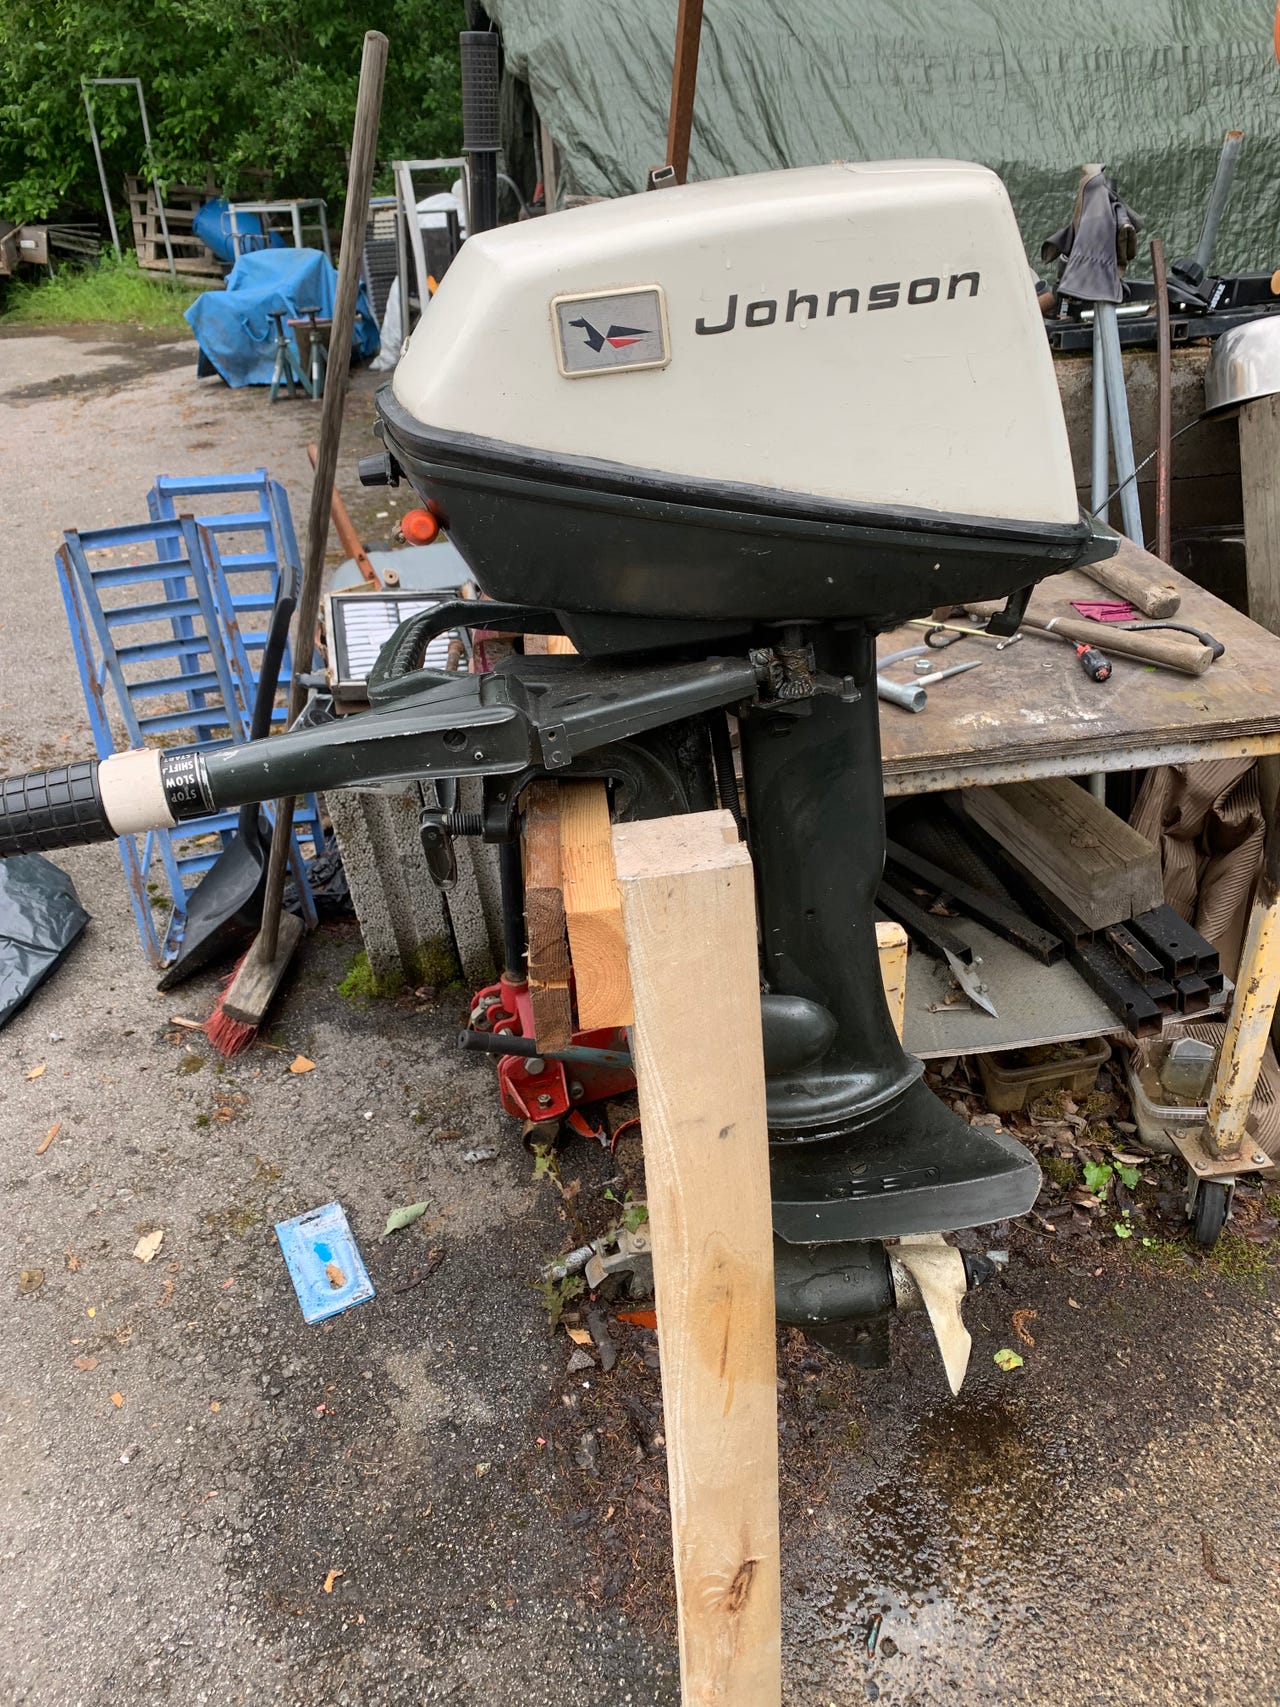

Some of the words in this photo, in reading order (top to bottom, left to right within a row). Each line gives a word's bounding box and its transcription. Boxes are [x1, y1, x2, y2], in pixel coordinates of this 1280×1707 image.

[695, 271, 981, 336] Johnson
[169, 760, 193, 773] SHIFT
[166, 774, 196, 789] SLOW
[171, 790, 197, 802] STOP
